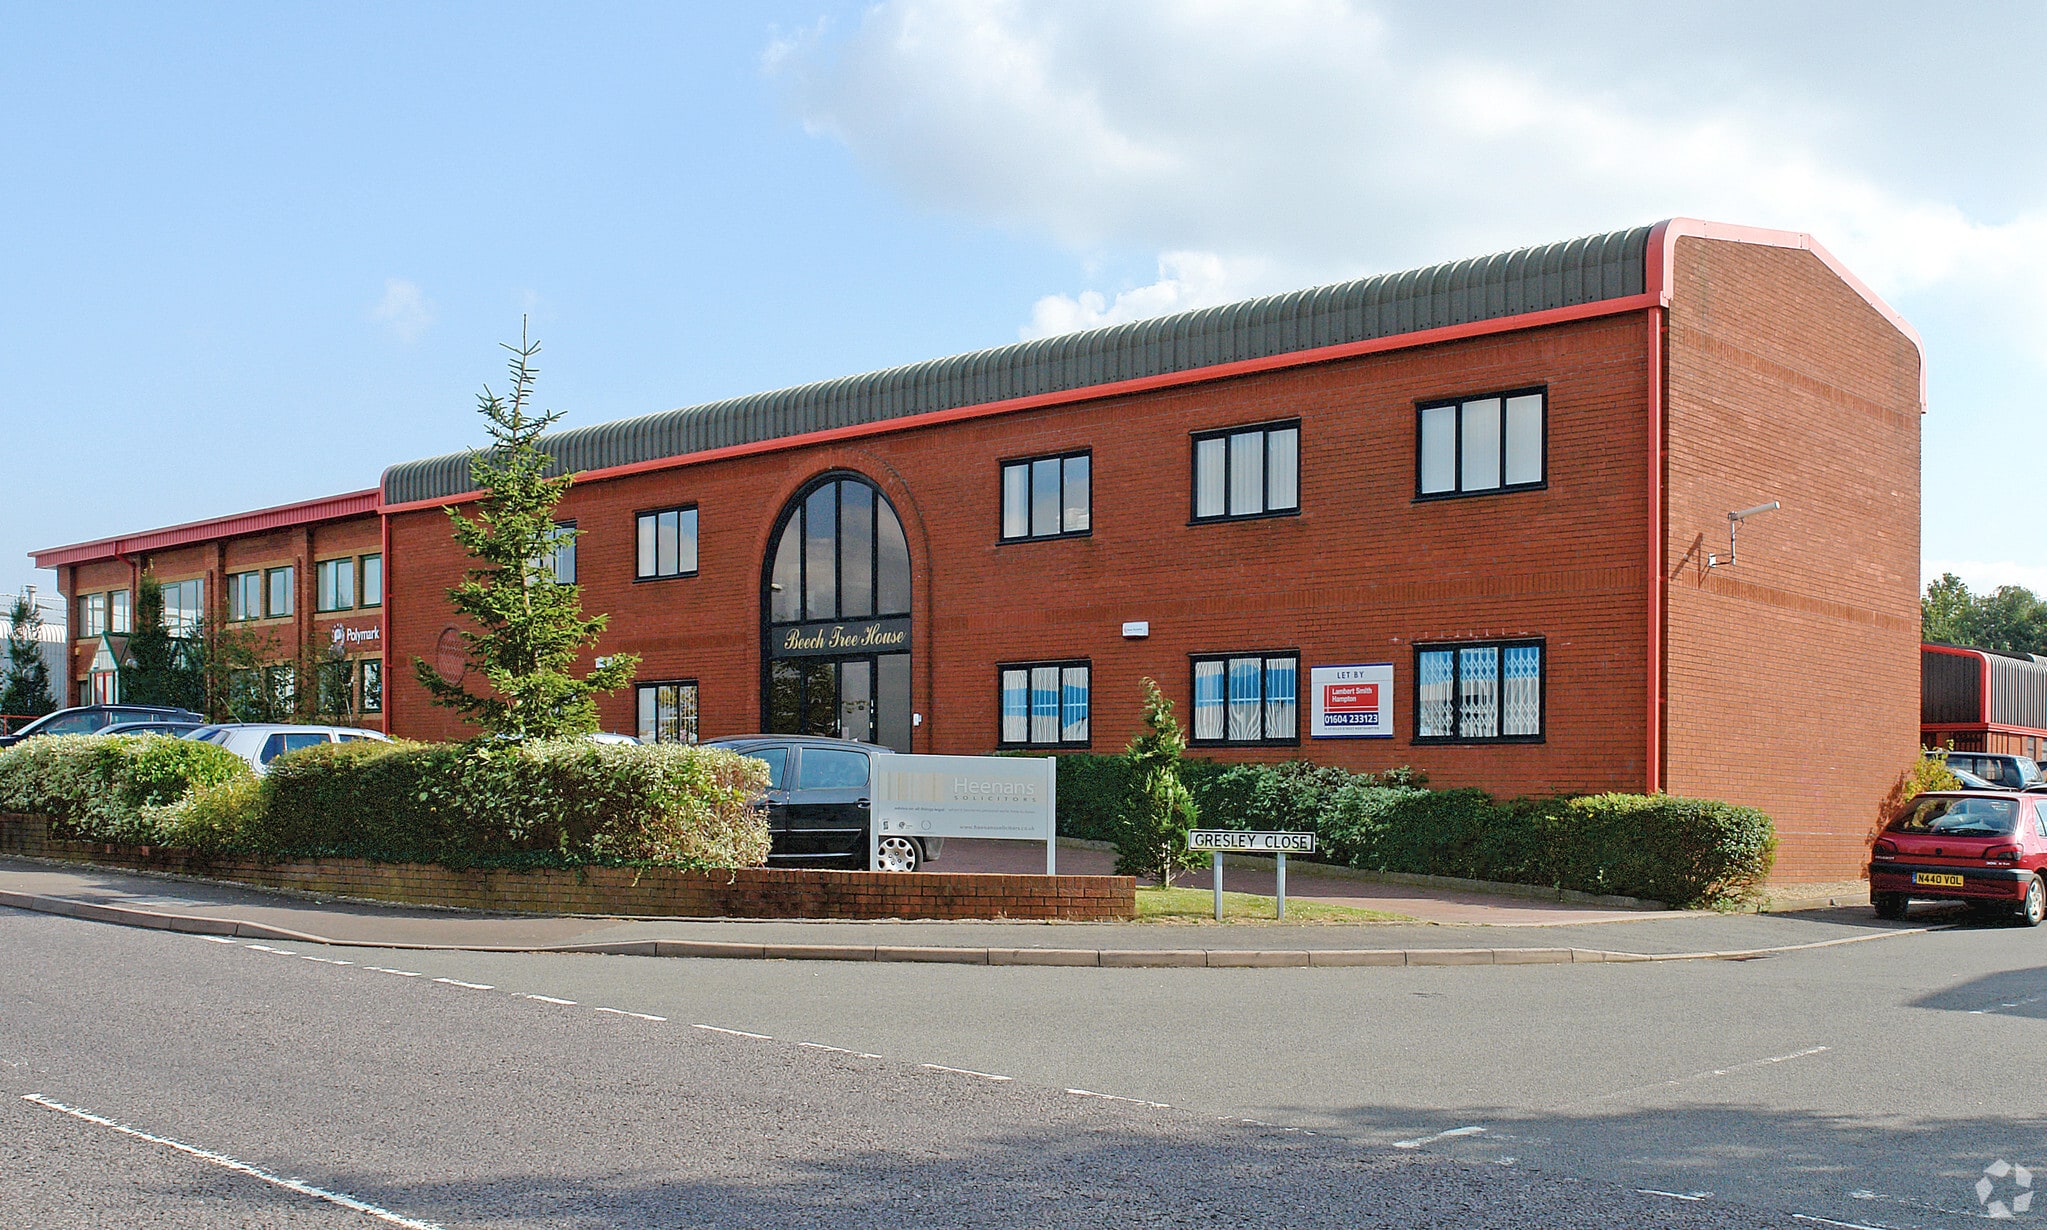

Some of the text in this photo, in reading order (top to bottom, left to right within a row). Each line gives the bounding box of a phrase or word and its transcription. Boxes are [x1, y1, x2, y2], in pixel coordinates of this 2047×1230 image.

[346, 625, 380, 645] Polymark
[784, 622, 907, 650] Beech Tree House
[1337, 671, 1365, 679] LET BY
[1332, 695, 1357, 703] Hampton
[1324, 714, 1378, 724] 01604 233123
[953, 777, 1035, 795] Heenans
[954, 795, 1037, 803] SOLICITORS
[1195, 833, 1308, 849] GRESLEY CLOSE
[1918, 873, 1962, 885] N440 VOL
